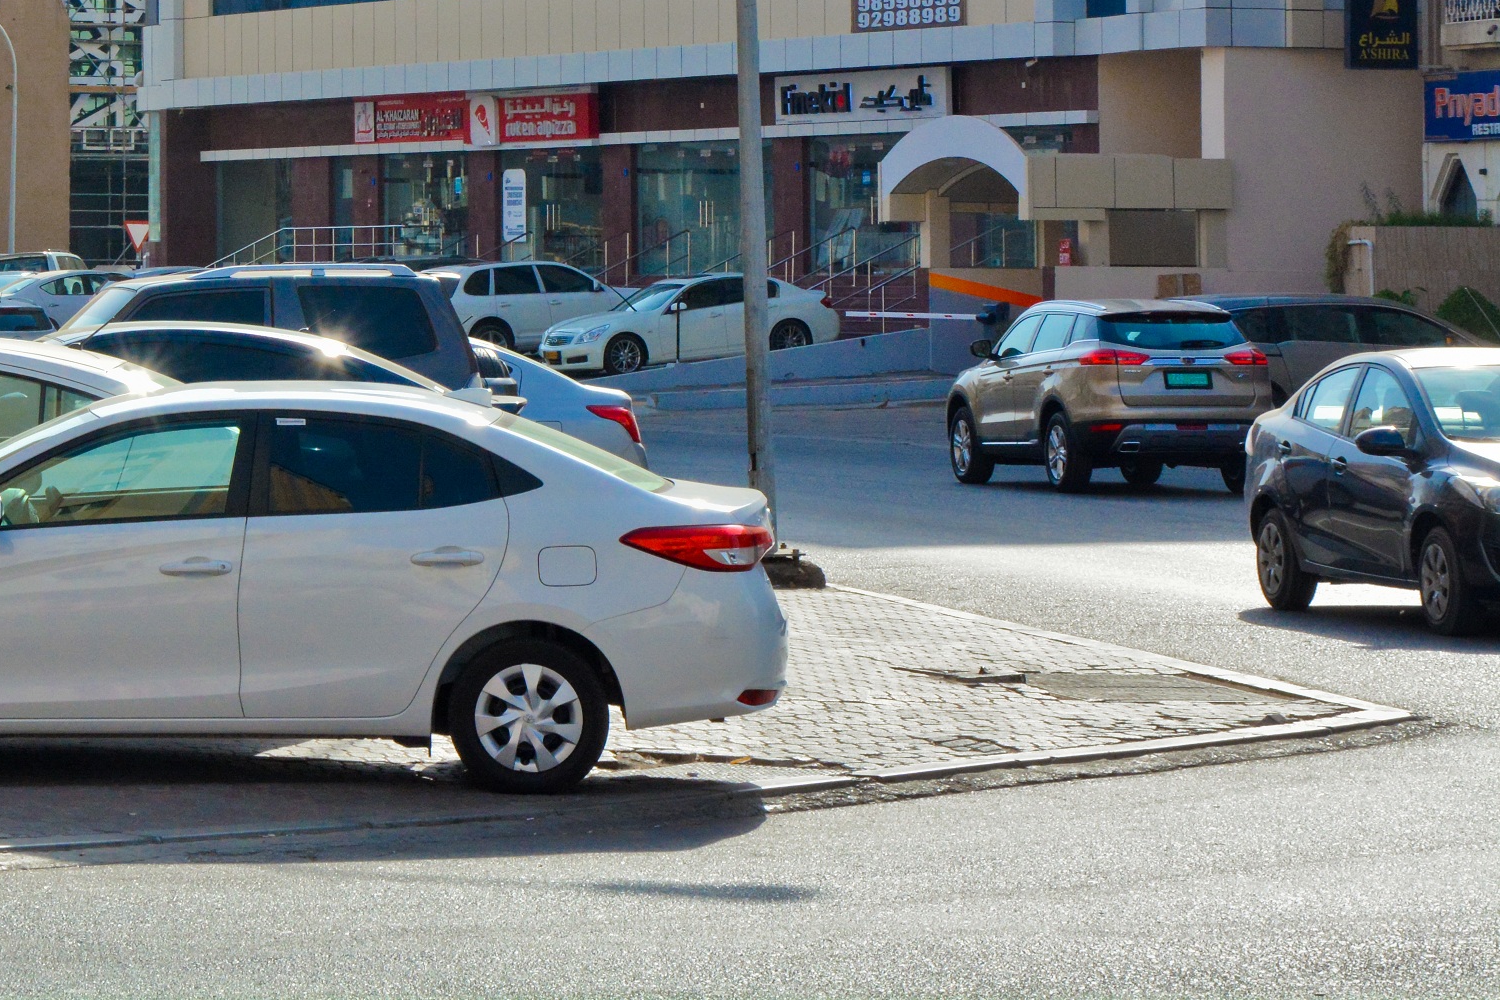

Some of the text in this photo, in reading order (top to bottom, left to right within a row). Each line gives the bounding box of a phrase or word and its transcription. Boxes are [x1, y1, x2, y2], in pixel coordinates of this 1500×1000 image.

[858, 6, 960, 28] 92988989
[1359, 30, 1410, 47] الشراع
[781, 82, 851, 115] Finekid
